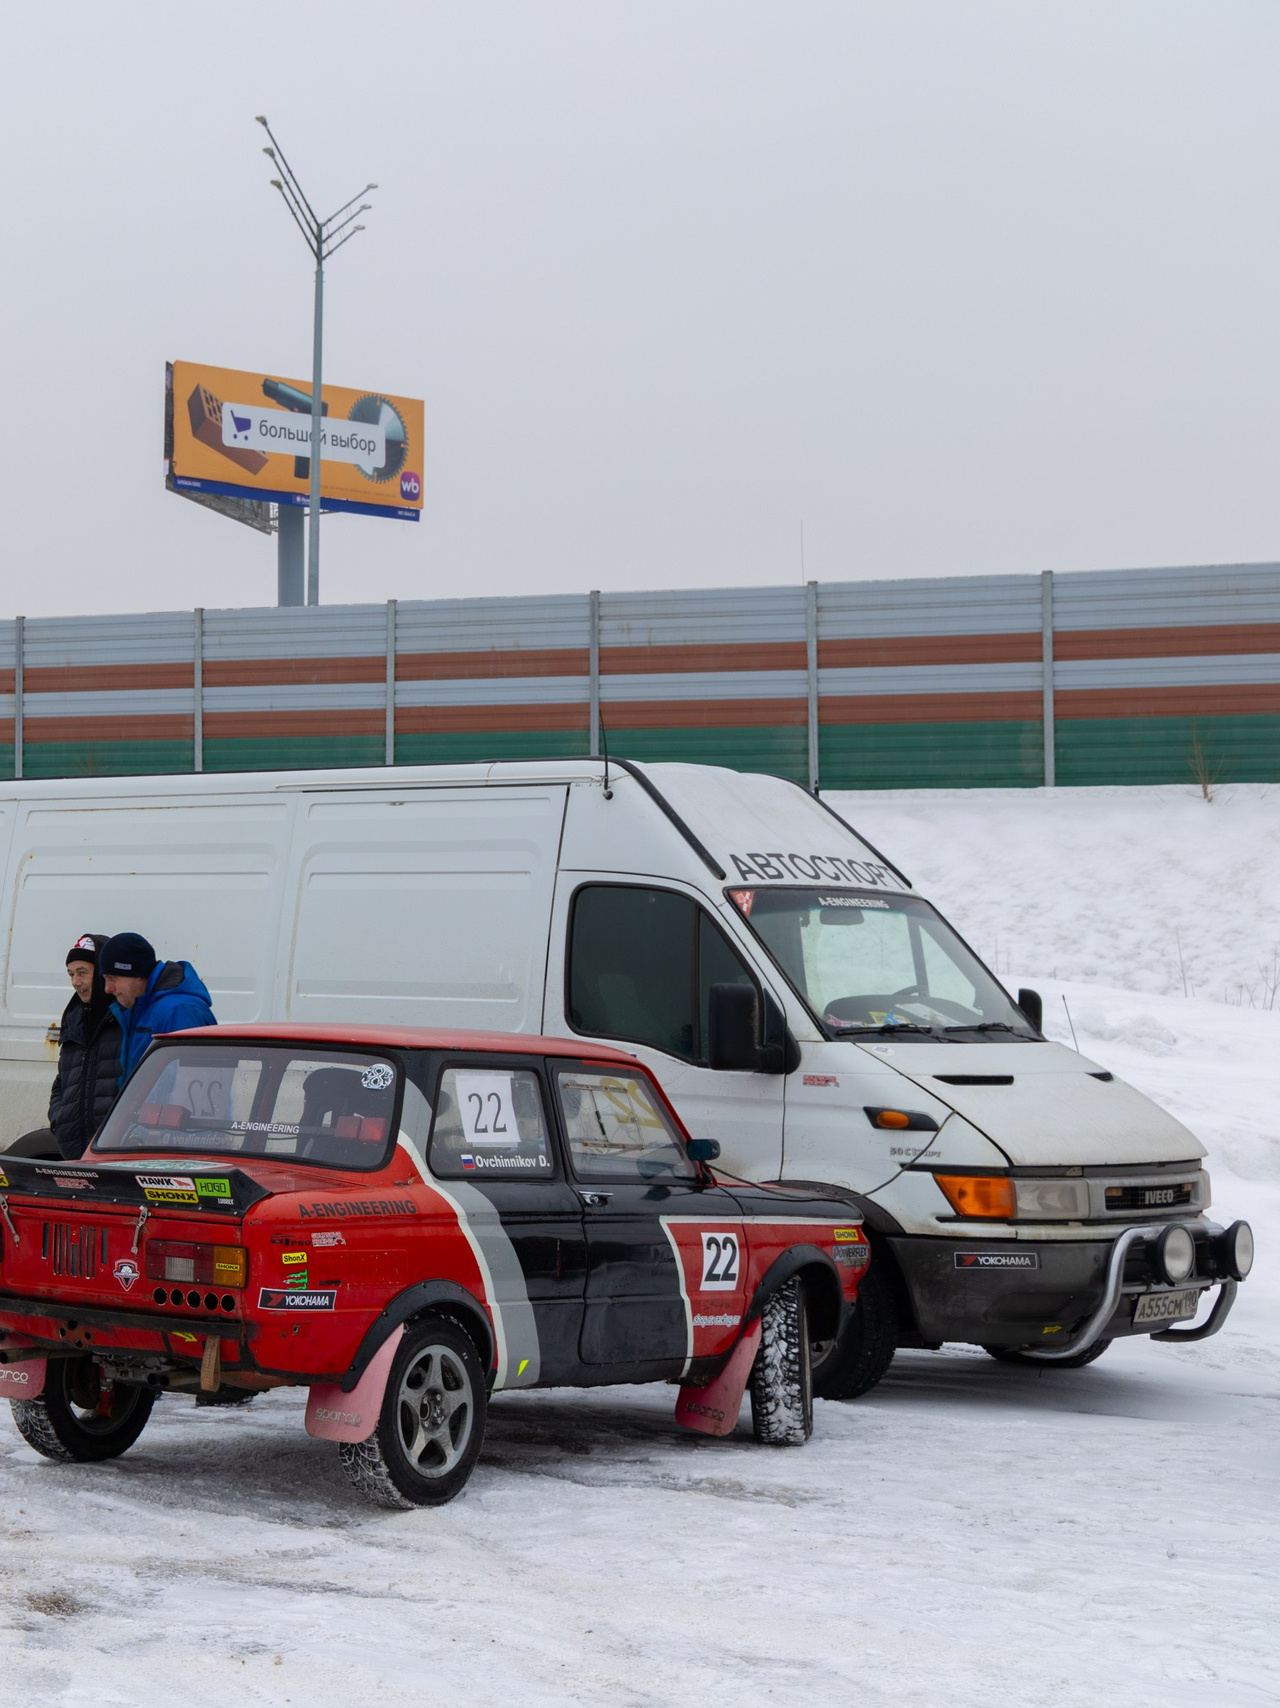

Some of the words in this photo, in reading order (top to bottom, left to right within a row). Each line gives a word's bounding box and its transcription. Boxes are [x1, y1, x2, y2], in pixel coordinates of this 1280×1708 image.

[331, 433, 376, 456] выбор
[401, 478, 420, 493] wb
[729, 853, 906, 890] АВТОСПОРТ
[818, 897, 890, 909] A-ENGINEERING
[468, 1092, 507, 1133] 22
[231, 1121, 300, 1134] A-ENGINEERING
[475, 1155, 536, 1168] Ovchinnikov
[538, 1155, 550, 1167] D.
[35, 1167, 99, 1178] A-ENGINEERING
[138, 1176, 174, 1186] HAWK
[200, 1182, 227, 1193] HOGO
[147, 1190, 196, 1201] SHONX
[1145, 1189, 1174, 1204] IVECO
[298, 1199, 417, 1218] A-ENGINEERING
[836, 1231, 857, 1239] SHONX
[283, 1254, 306, 1262] ShonX
[704, 1236, 737, 1282] 22
[977, 1256, 1031, 1265] YOKOHAMA
[285, 1295, 329, 1306] YOKOHAMA
[1137, 1296, 1182, 1319] А555СМ
[315, 1407, 361, 1425] sparco
